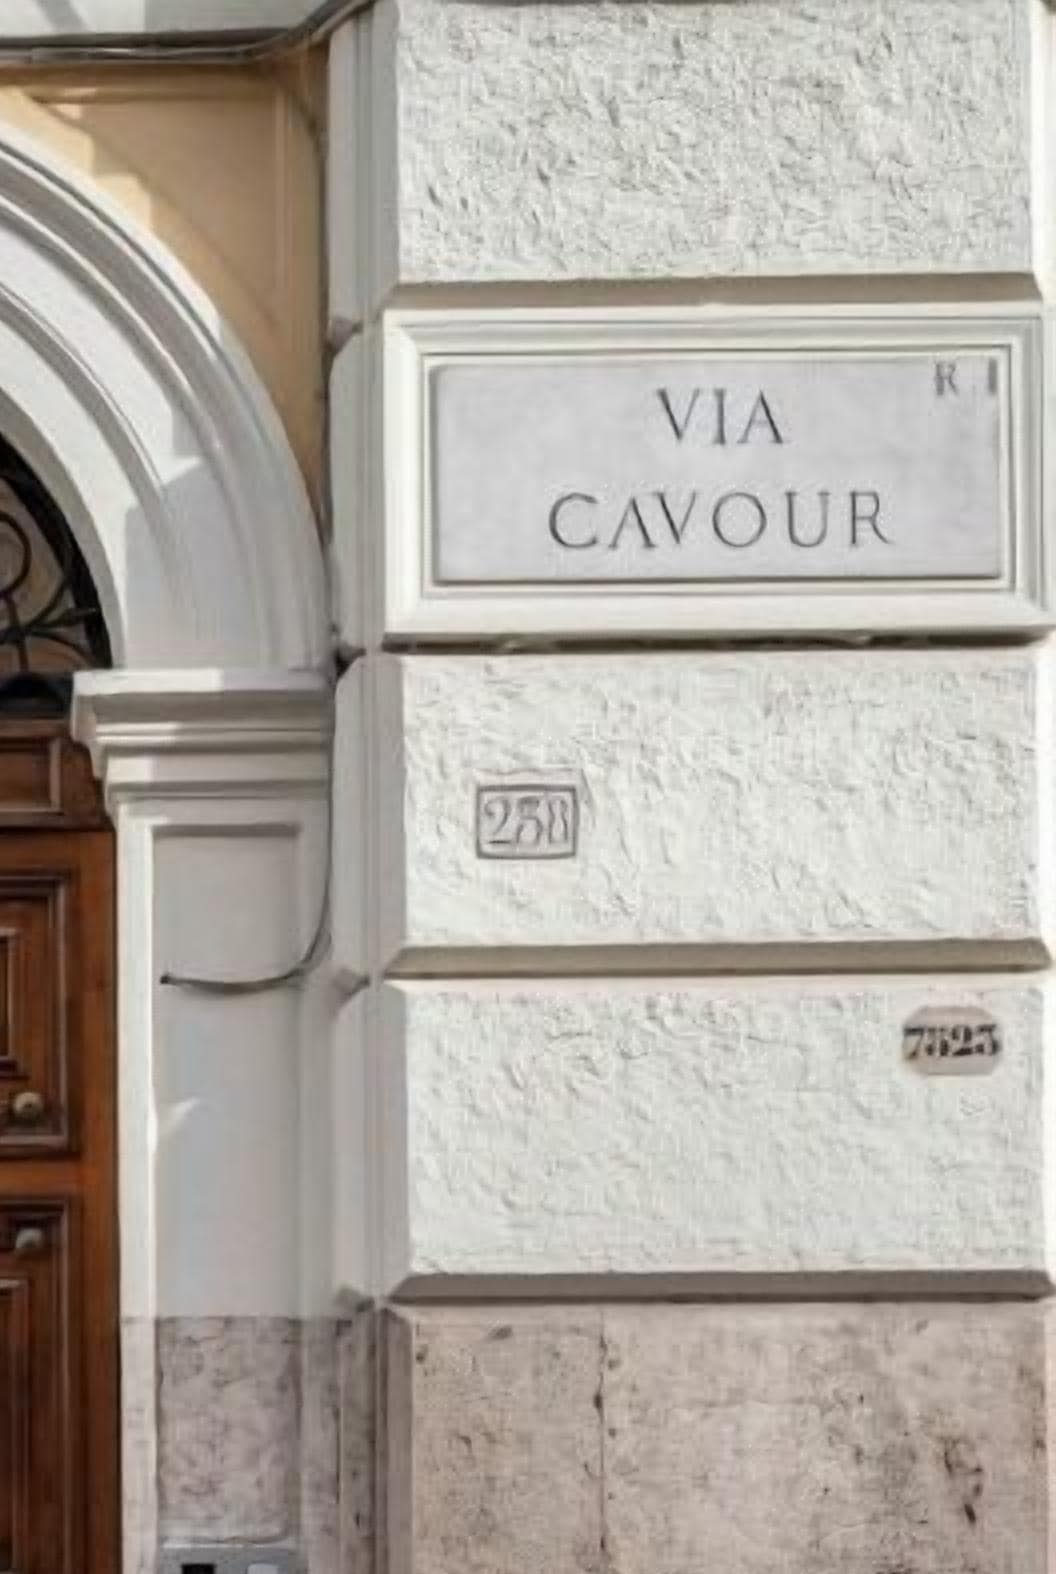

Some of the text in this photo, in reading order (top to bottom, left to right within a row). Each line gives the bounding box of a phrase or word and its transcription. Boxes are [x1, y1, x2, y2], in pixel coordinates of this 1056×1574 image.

[934, 361, 959, 396] R
[656, 387, 785, 446] VIA
[548, 490, 895, 551] CAVOUR
